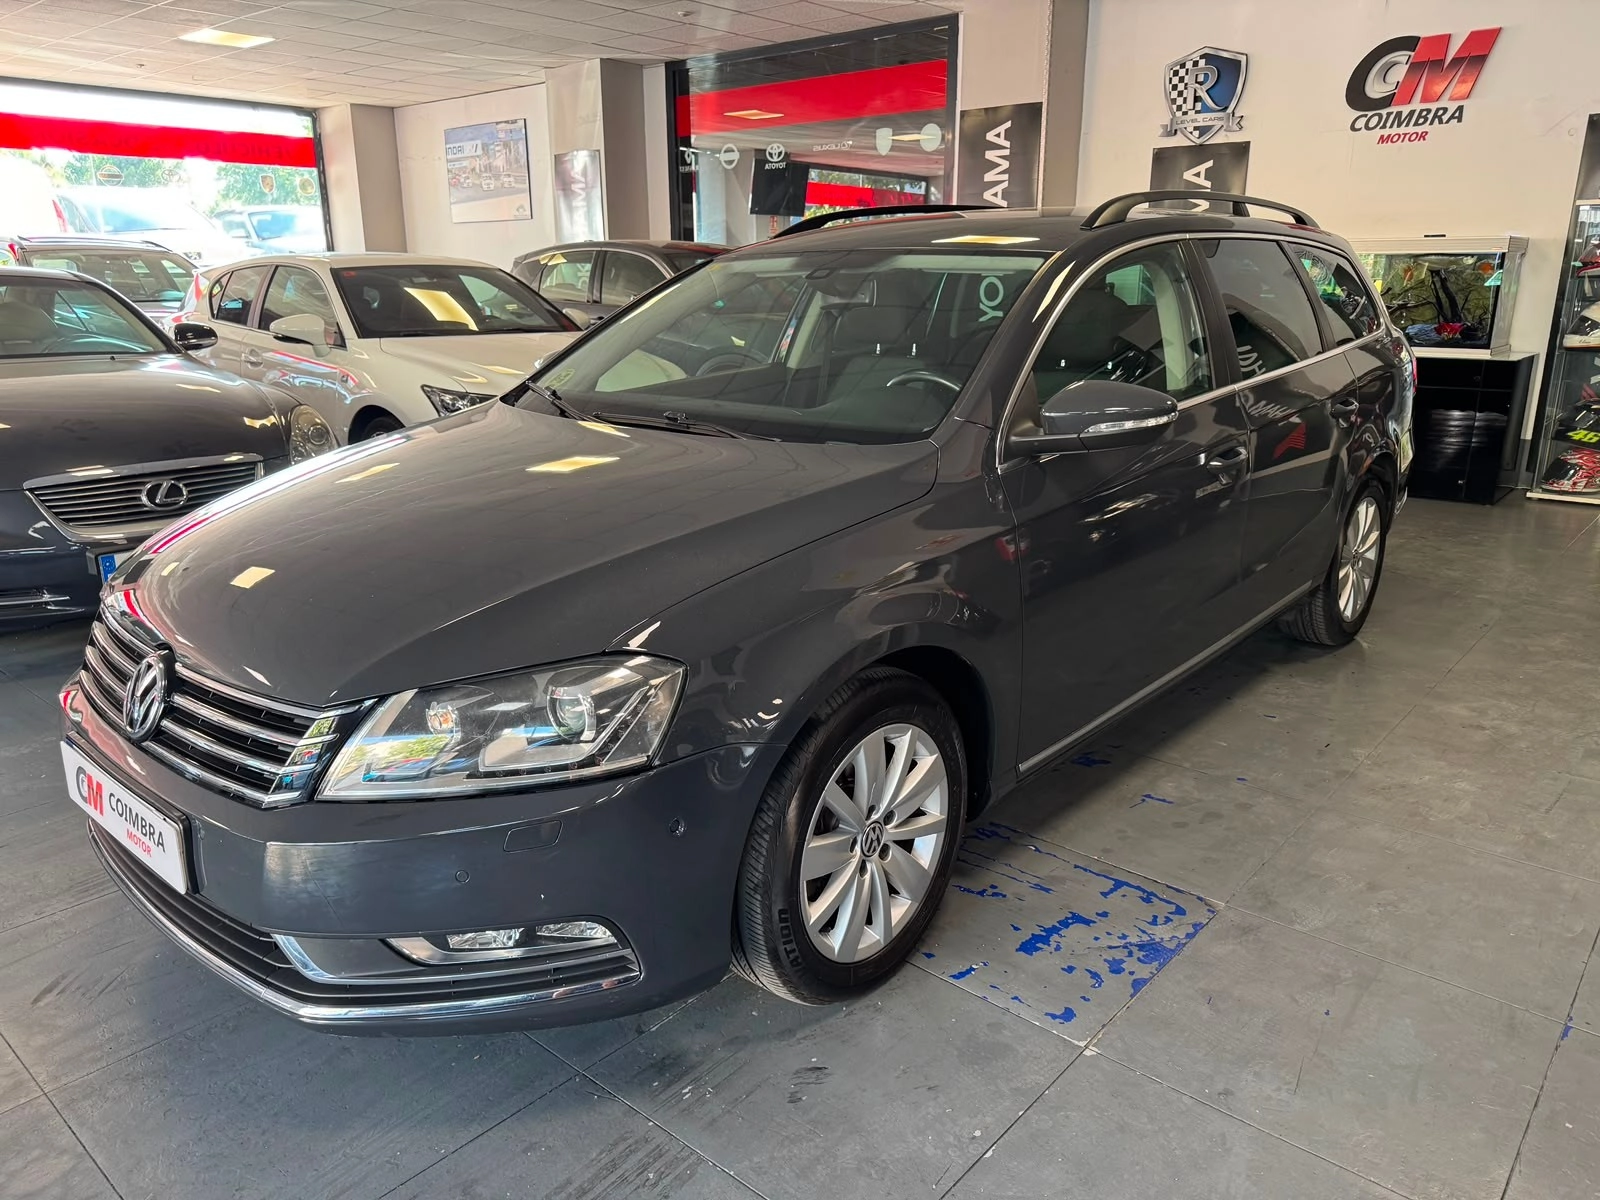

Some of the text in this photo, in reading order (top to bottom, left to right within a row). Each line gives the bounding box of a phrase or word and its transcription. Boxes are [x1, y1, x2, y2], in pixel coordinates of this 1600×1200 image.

[1175, 115, 1225, 126] LEVEL CARS
[1349, 104, 1465, 133] COIMBRA
[1376, 129, 1430, 145] MOTOR
[108, 792, 166, 853] COIMBRA
[126, 827, 152, 858] MOTOR
